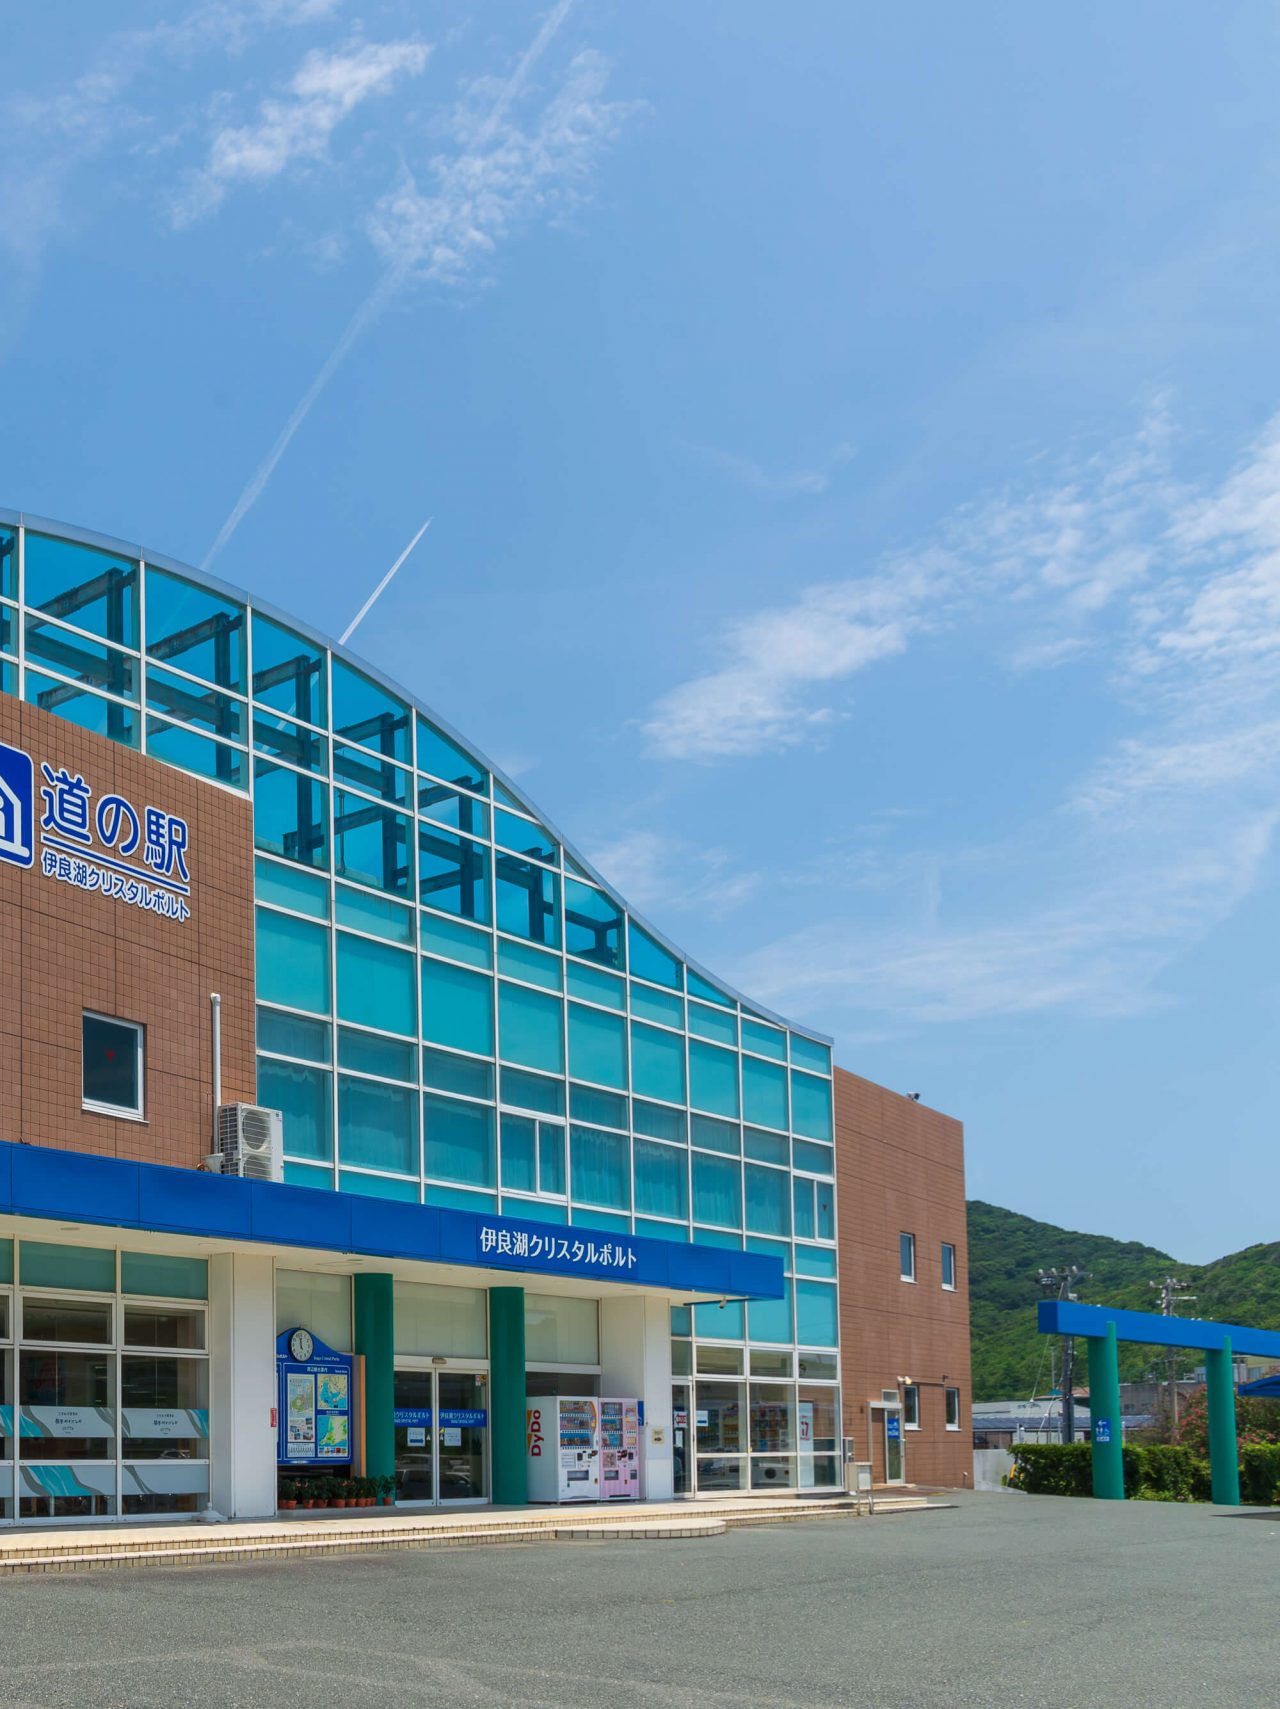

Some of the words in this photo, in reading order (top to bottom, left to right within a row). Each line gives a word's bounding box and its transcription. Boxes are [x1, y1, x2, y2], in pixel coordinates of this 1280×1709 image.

[41, 762, 190, 882] 道の駅
[42, 848, 190, 923] 伊良湖クリスタルポルト
[480, 1226, 637, 1269] 伊良湖クリスタルポルト
[531, 1409, 545, 1456] DyDo
